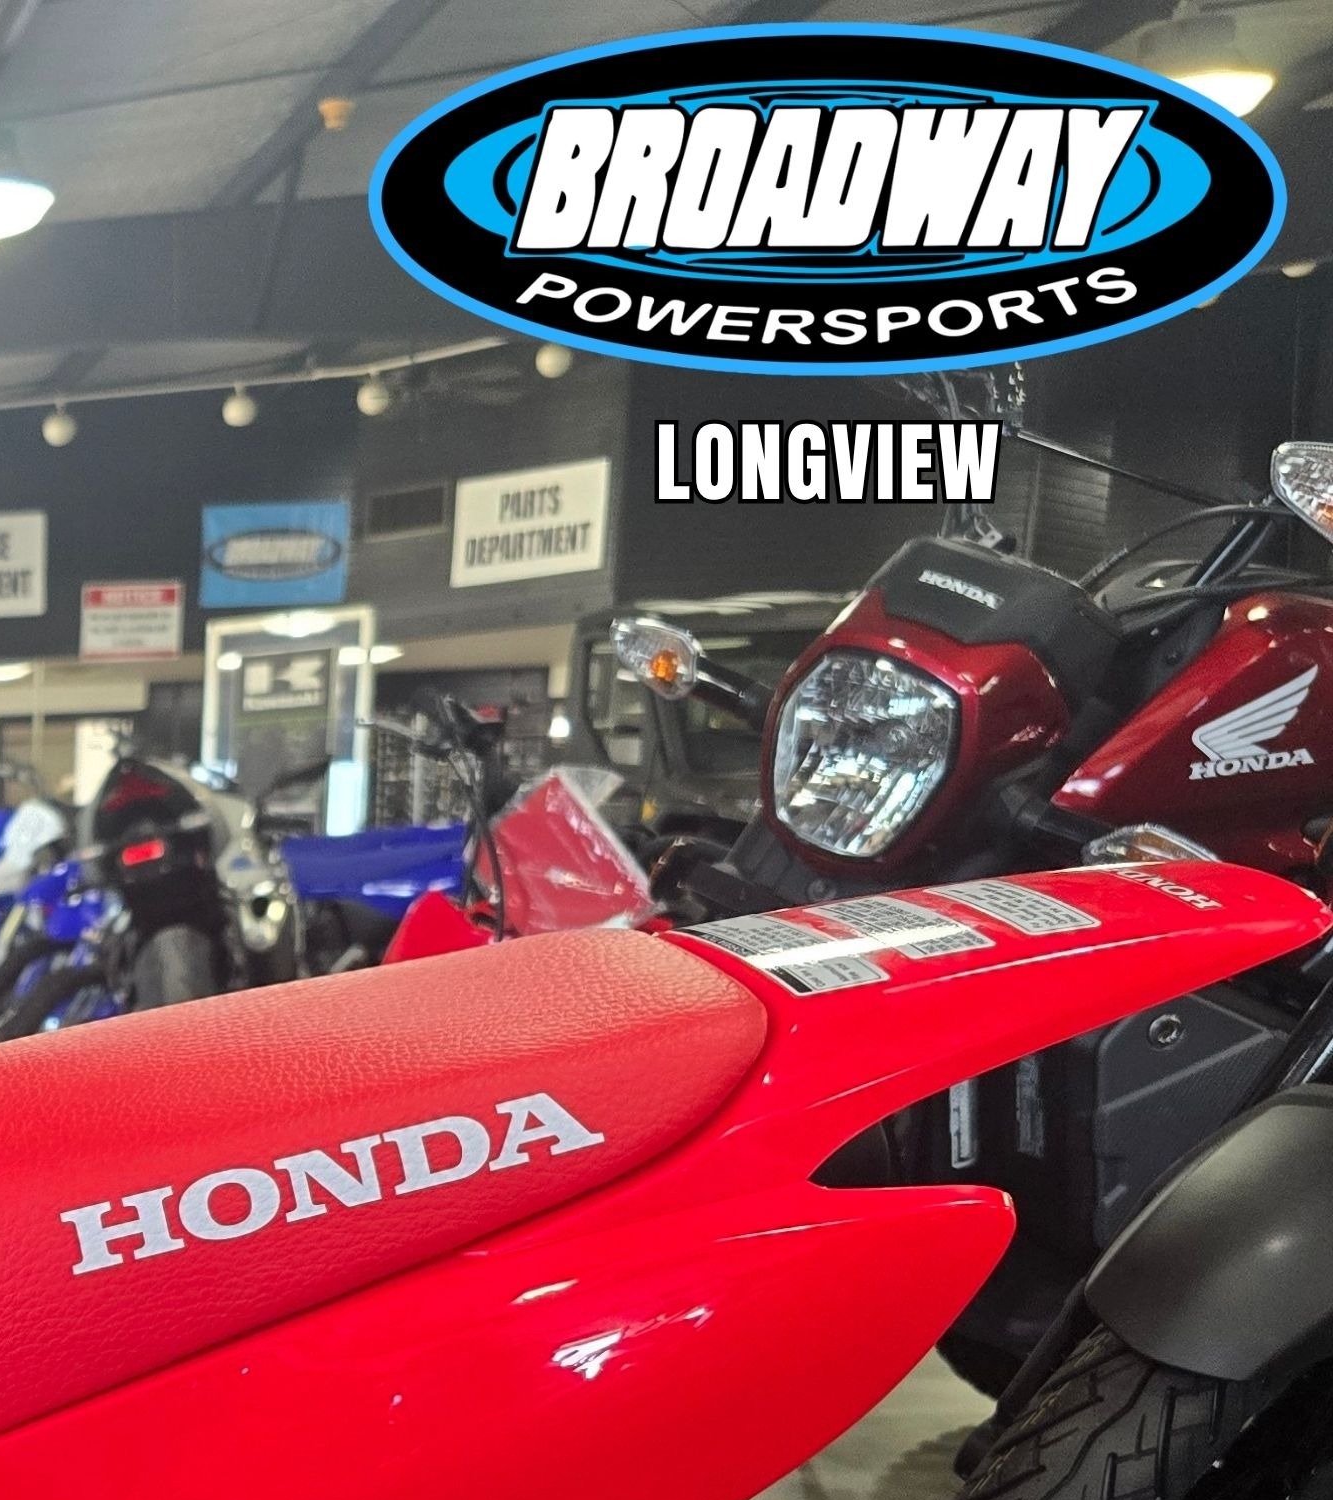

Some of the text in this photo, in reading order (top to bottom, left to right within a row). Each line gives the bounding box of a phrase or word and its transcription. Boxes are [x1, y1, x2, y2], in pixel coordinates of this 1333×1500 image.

[499, 485, 561, 522] PARTS
[466, 522, 591, 567] DEPARTMENT
[919, 569, 1005, 611] HONDA
[1189, 748, 1315, 780] HONDA
[60, 1092, 604, 1275] HONDA
